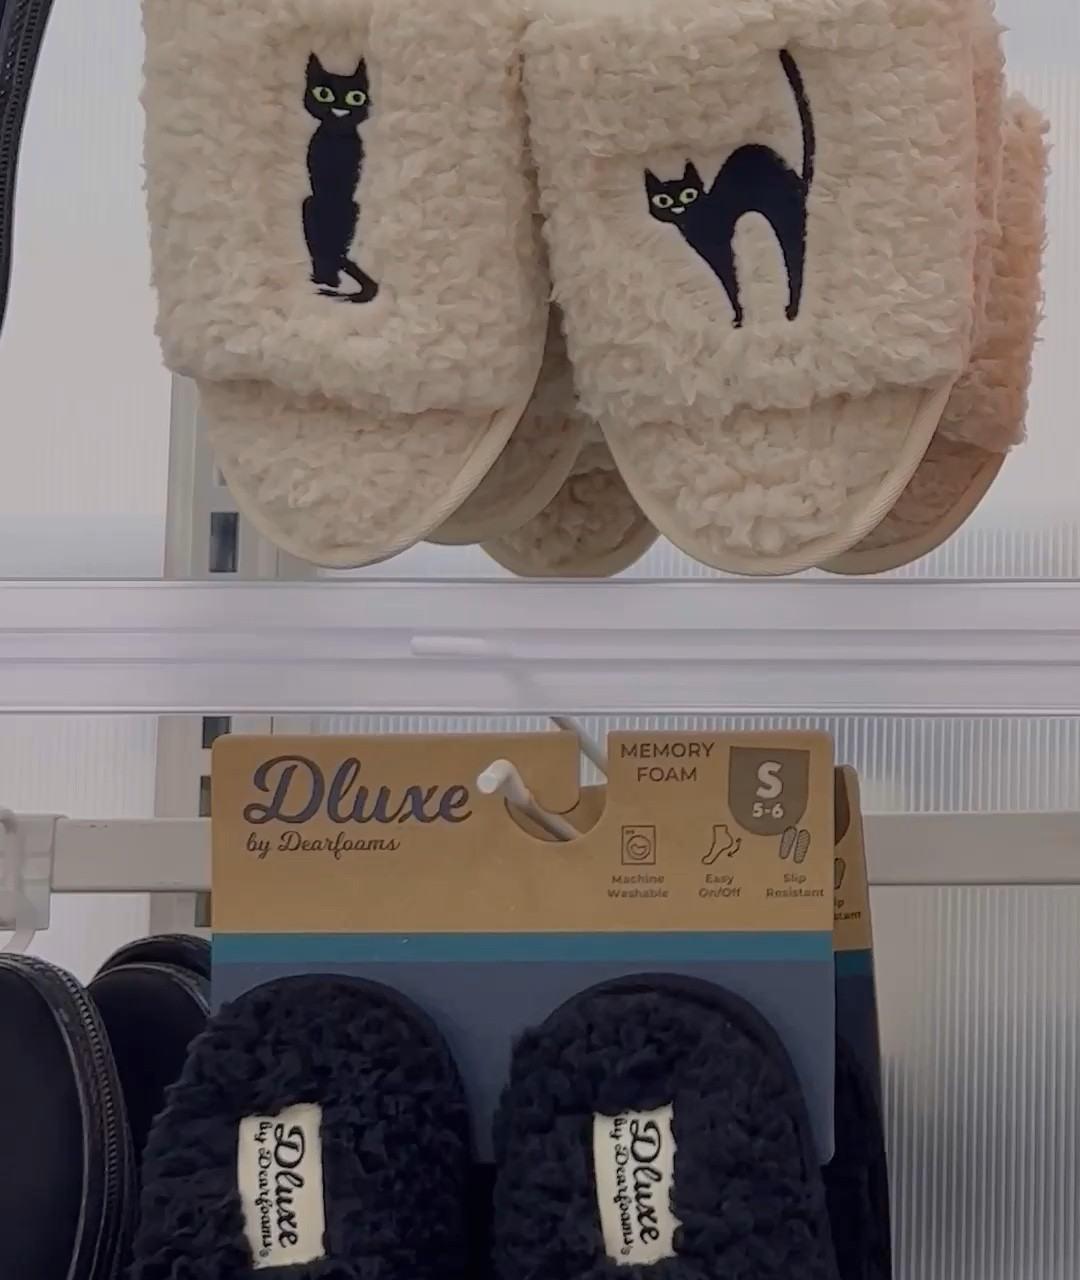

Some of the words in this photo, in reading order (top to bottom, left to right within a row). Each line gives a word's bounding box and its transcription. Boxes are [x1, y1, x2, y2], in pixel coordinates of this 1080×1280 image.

[620, 741, 716, 761] MEMORY
[636, 766, 697, 783] FOAM
[756, 761, 785, 799] S
[242, 755, 473, 825] Dluxe
[751, 803, 784, 819] 5-6
[246, 832, 271, 859] by
[278, 831, 400, 860] Dearfoams
[612, 874, 664, 884] Machine
[705, 873, 735, 886] Easy
[784, 873, 806, 885] Slip
[608, 888, 669, 898] Washable
[699, 887, 742, 898] On/Off
[766, 887, 824, 898] Resistant
[254, 1121, 273, 1144] by
[274, 1123, 305, 1249] Dluxe
[630, 1119, 662, 1245] Dluxe
